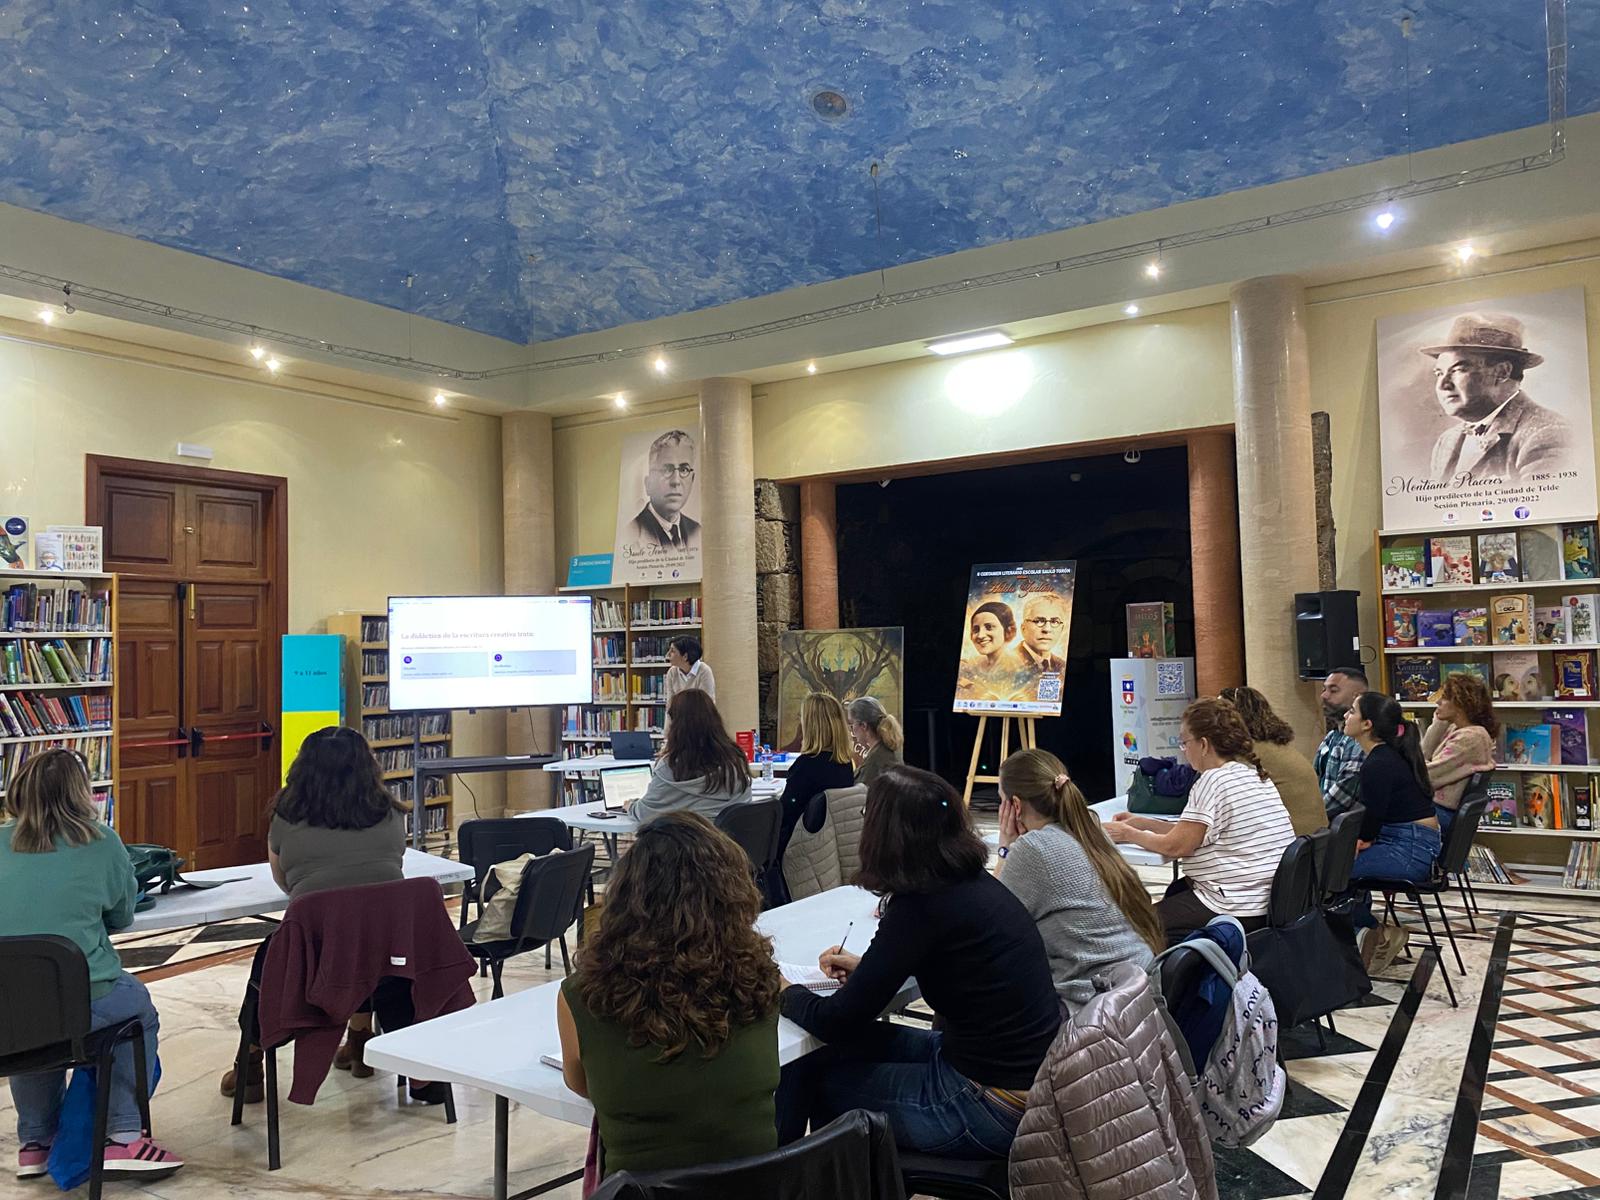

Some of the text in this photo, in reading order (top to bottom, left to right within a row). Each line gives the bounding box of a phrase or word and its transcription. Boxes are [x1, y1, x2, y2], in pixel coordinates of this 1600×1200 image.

[1532, 473, 1550, 481] 1885
[1558, 470, 1578, 479] 1938
[1385, 471, 1503, 496] Montiano Placeres
[1415, 494, 1431, 503] Hijo
[1434, 492, 1472, 502] predilecto
[1473, 490, 1482, 498] de
[1495, 487, 1524, 495] Ciudad
[1538, 484, 1560, 492] Telde
[1434, 501, 1459, 509] Sesión
[1497, 495, 1540, 505] 29/09/2022
[410, 631, 441, 639] didáctica
[442, 631, 451, 639] de
[459, 630, 489, 638] escritura
[490, 630, 517, 638] creativa
